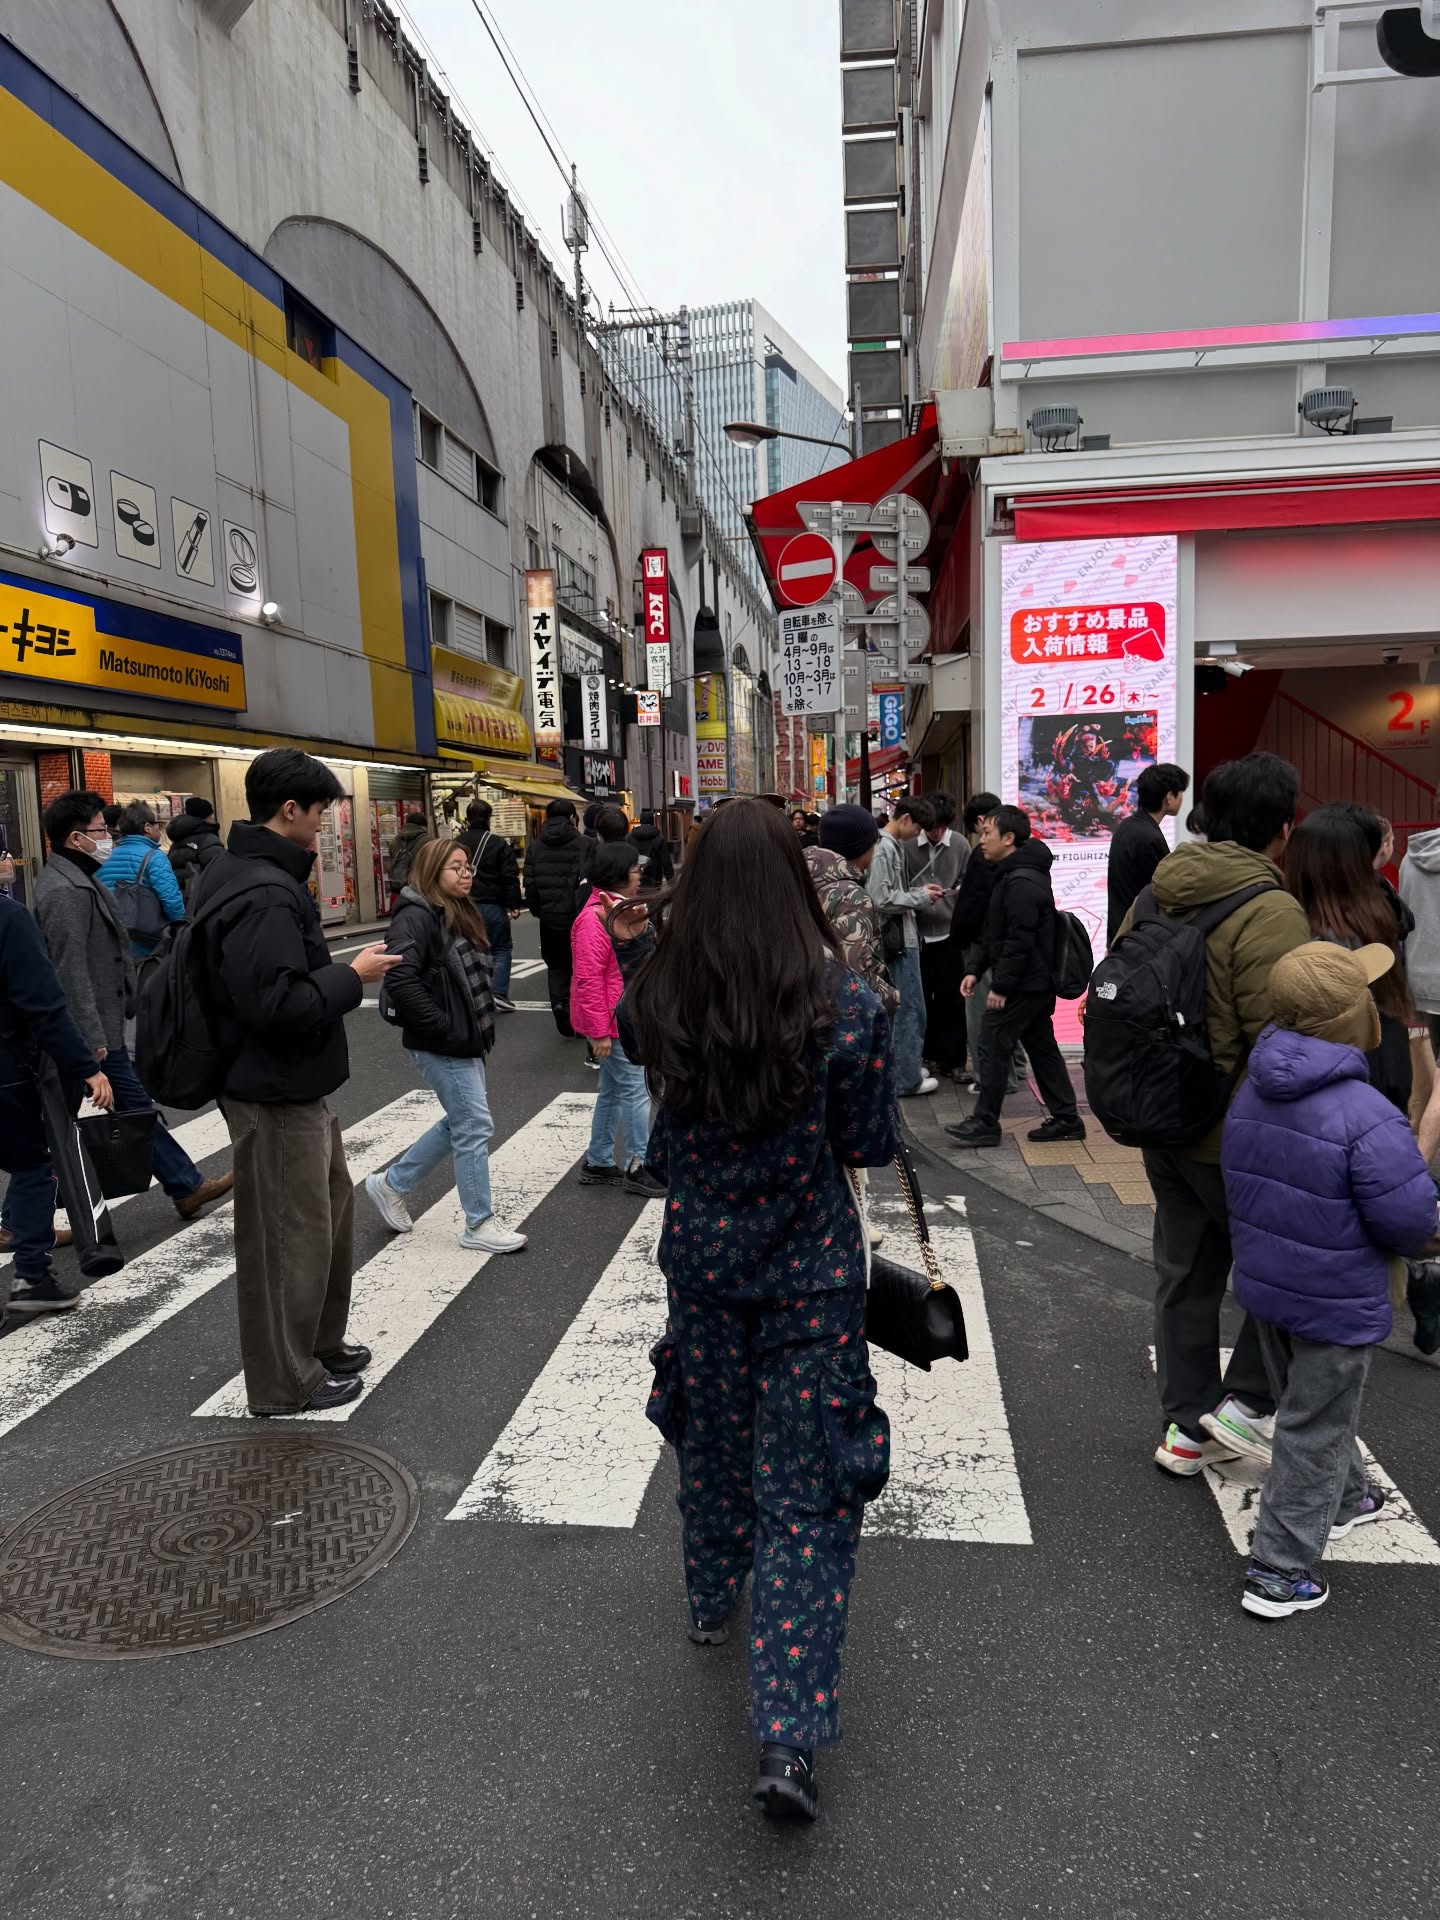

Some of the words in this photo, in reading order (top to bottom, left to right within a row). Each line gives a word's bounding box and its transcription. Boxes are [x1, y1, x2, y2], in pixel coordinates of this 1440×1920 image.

[649, 592, 665, 636] KFC
[783, 612, 833, 630] 自転車を除く
[1023, 607, 1148, 634] おすすめ景品
[0, 608, 76, 662] キヨシ
[784, 631, 818, 645] 日曜の
[1022, 633, 1109, 658] 入荷情報
[100, 649, 183, 684] Matsumoto
[185, 666, 230, 693] KiYoshi
[533, 613, 556, 728] オヤイデ電気
[786, 699, 813, 711] を除く
[884, 696, 898, 740] GiGO
[1387, 691, 1430, 736] 2F
[700, 776, 726, 787] Hobby
